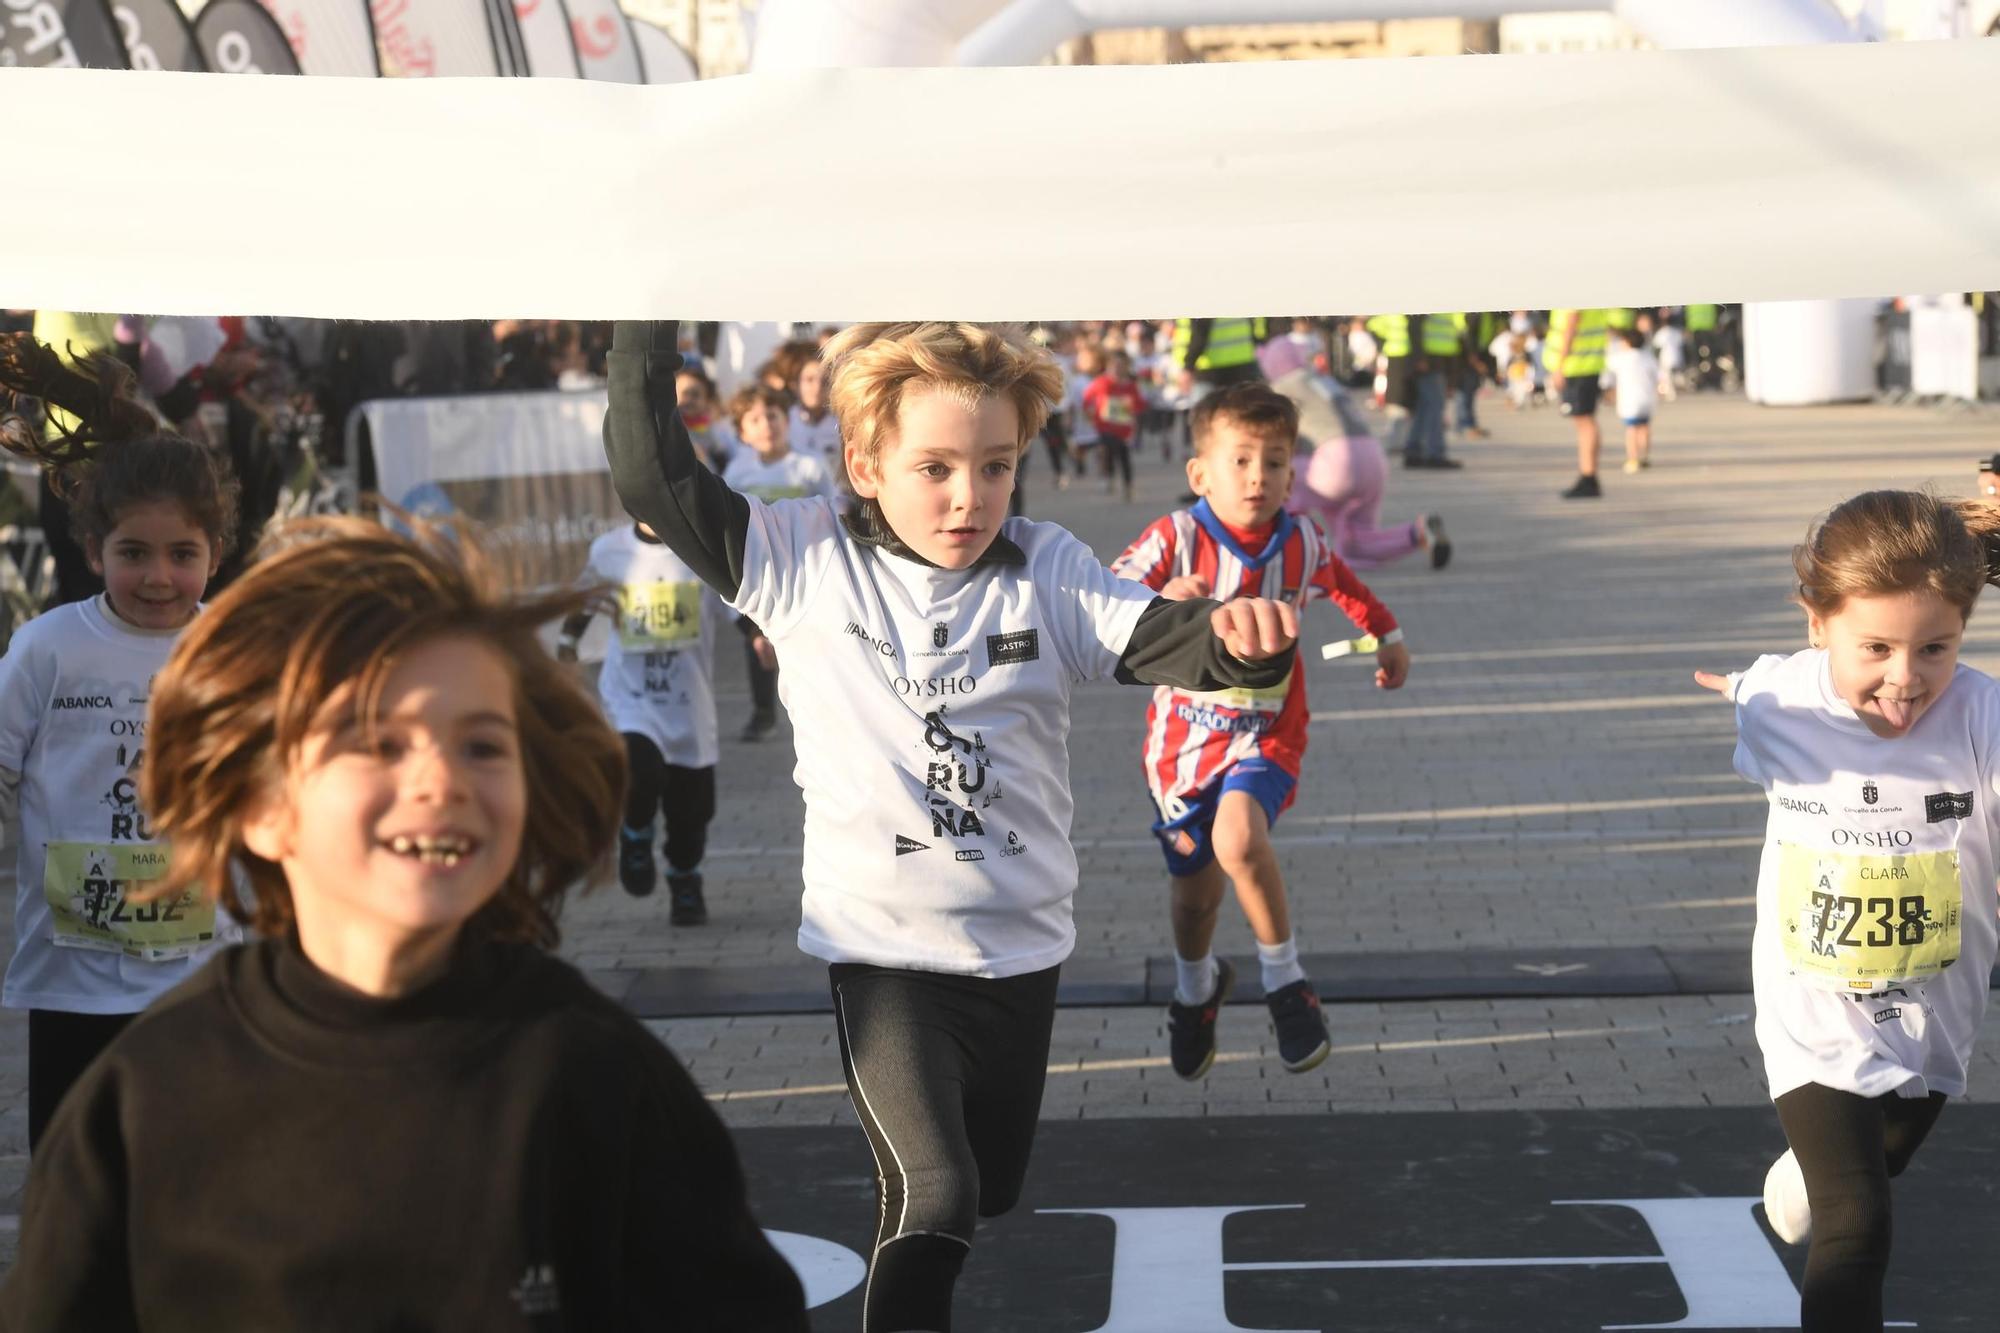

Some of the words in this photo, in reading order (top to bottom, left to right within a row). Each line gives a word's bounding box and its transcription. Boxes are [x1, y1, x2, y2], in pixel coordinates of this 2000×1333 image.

[996, 640, 1031, 651] CASTRO
[893, 675, 977, 697] OYSHO
[1178, 704, 1238, 732] RIYADH
[926, 762, 986, 793] RU
[1934, 801, 1965, 810] CASTRO
[1831, 829, 1912, 848] OYSHO
[132, 853, 166, 865] MARA
[1860, 867, 1909, 880] CLARA
[1811, 890, 1925, 947] 7238
[1875, 1010, 1901, 1022] GADIS
